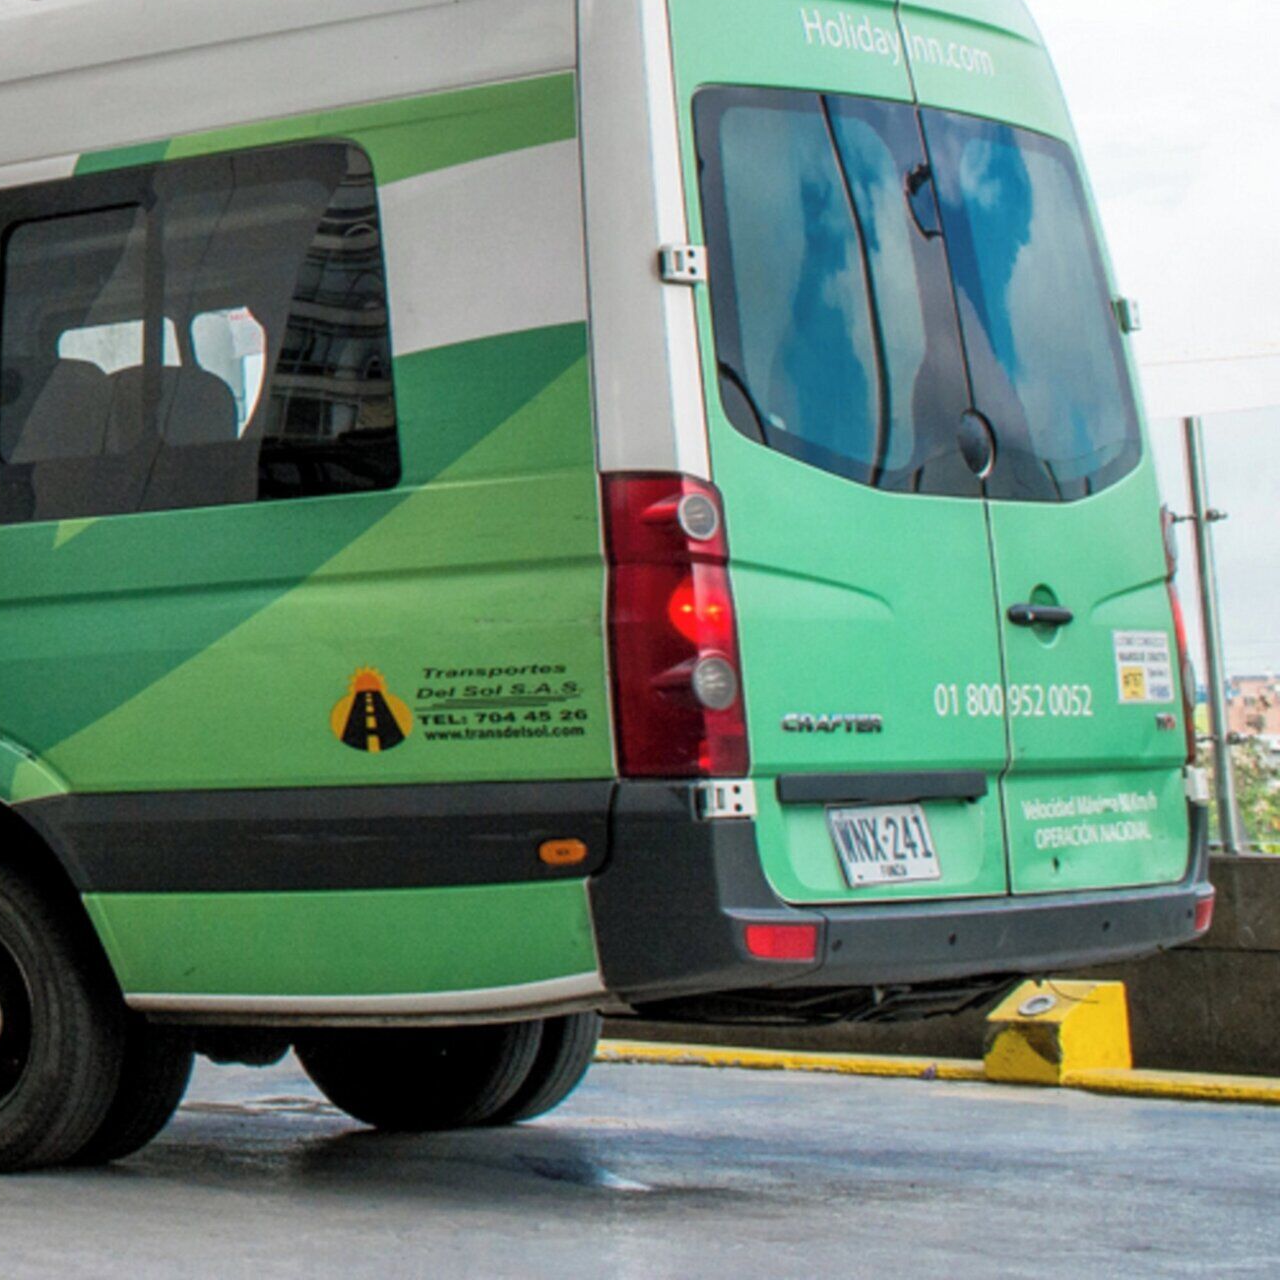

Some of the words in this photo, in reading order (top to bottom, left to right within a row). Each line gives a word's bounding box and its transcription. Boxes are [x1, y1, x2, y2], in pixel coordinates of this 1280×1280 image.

[423, 664, 567, 680] Transportes
[416, 687, 457, 700] Del
[463, 685, 503, 697] Sol
[934, 683, 959, 716] 01
[966, 683, 1005, 717] 800
[1008, 684, 1045, 717] 952
[1048, 684, 1093, 717] 0052
[418, 713, 468, 726] TEL:
[474, 711, 517, 724] 704
[523, 709, 552, 722] 45
[559, 708, 588, 721] 26
[782, 713, 884, 733] CRAFTER
[1021, 796, 1075, 821] Velocidad
